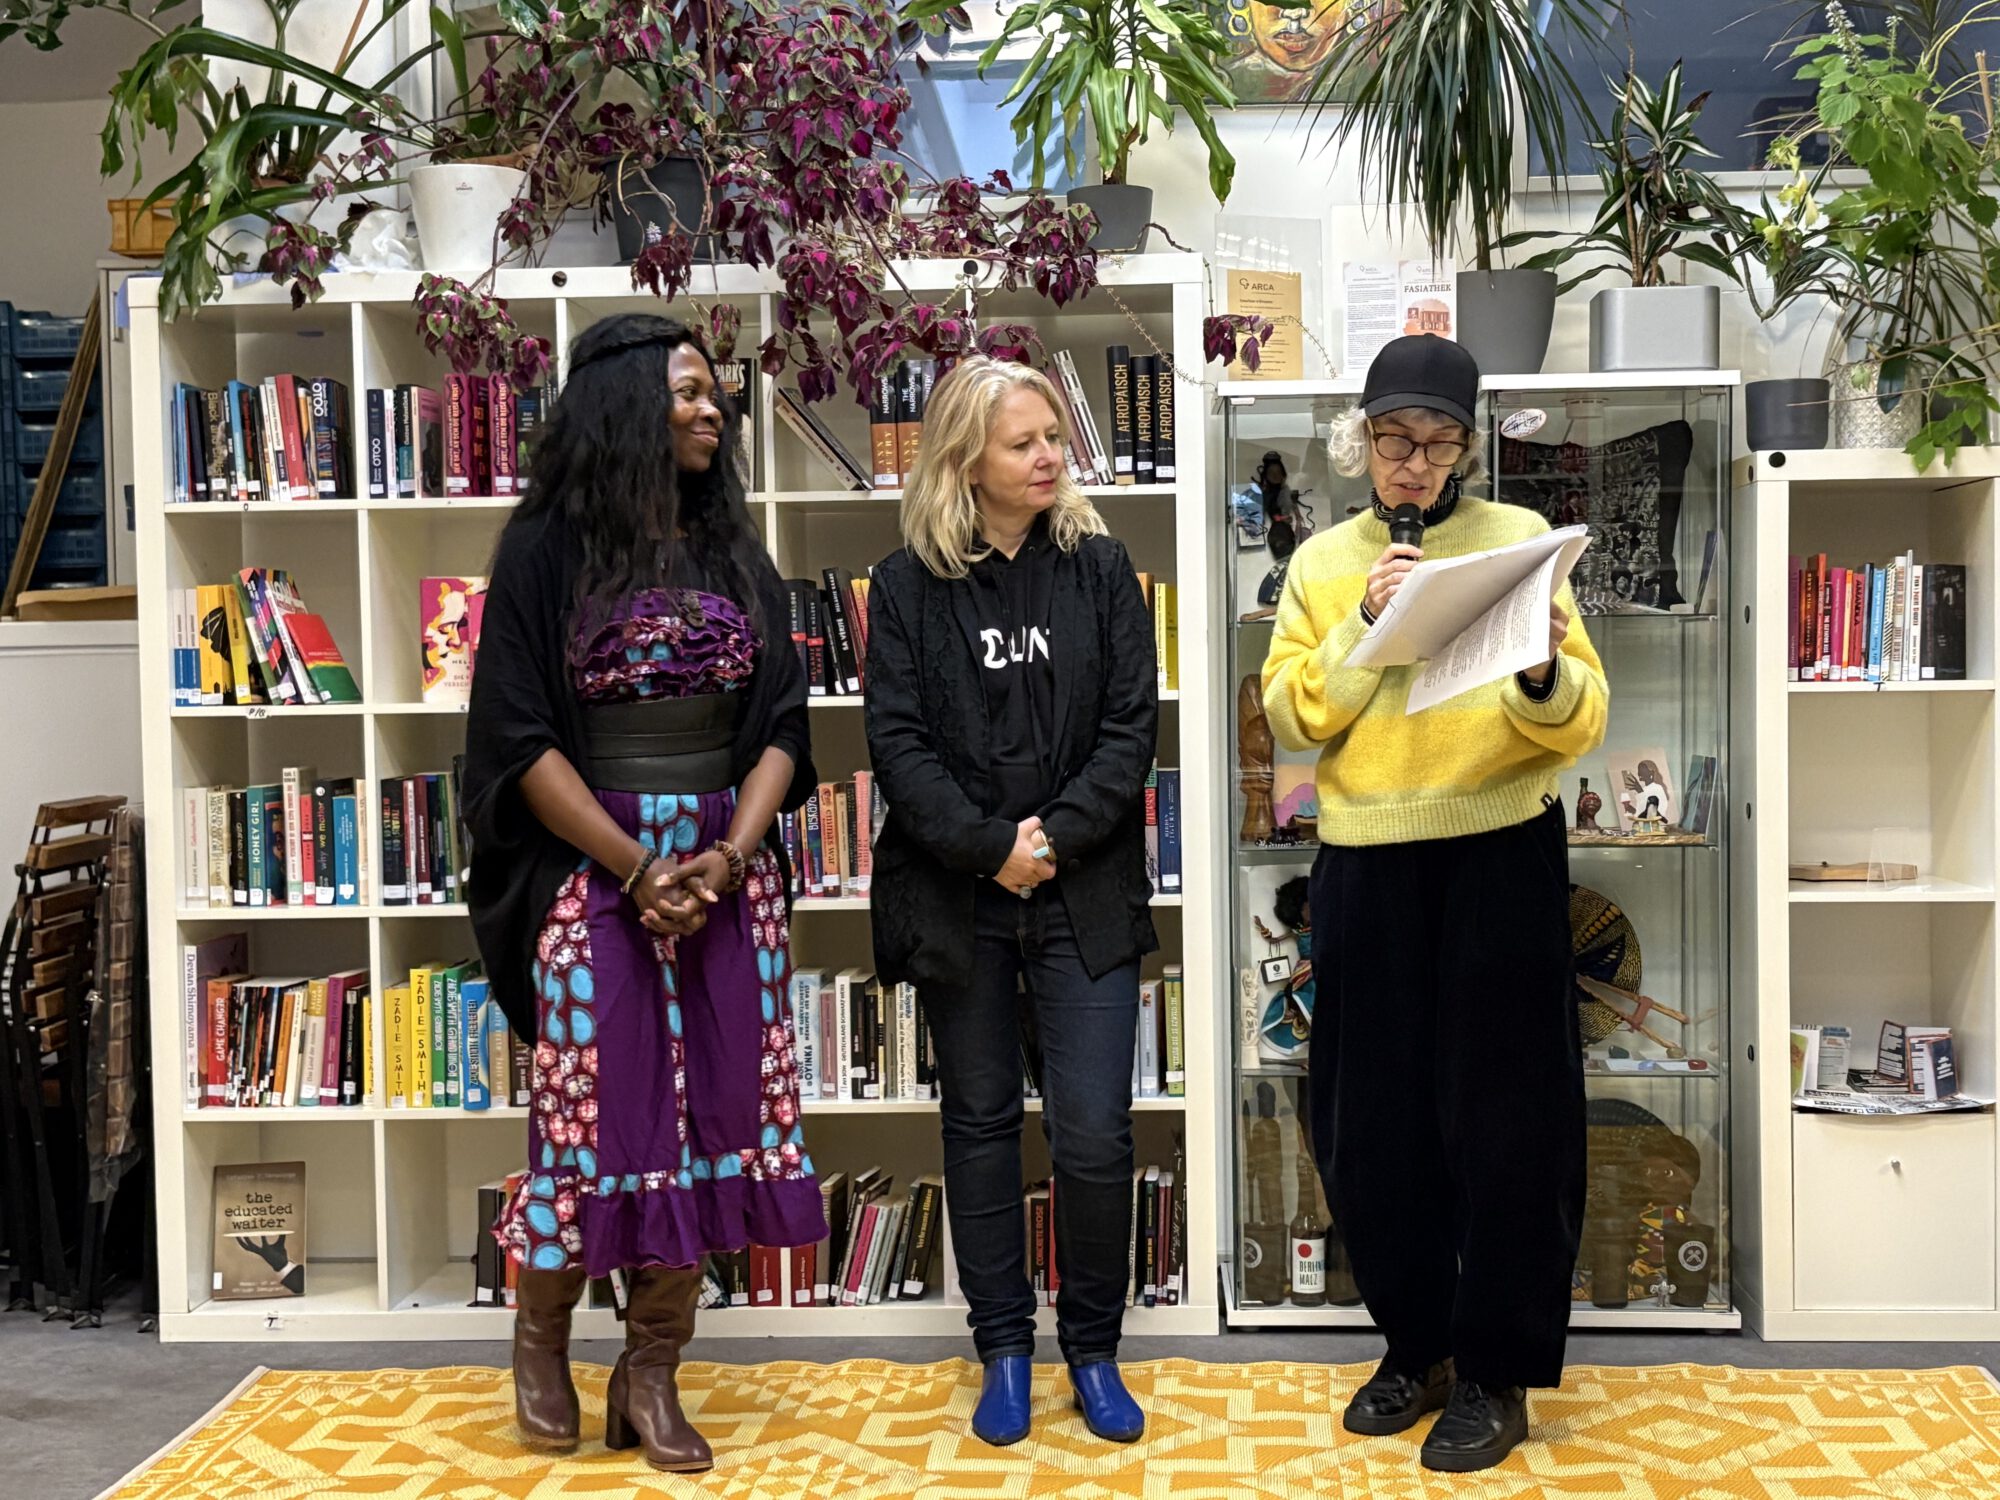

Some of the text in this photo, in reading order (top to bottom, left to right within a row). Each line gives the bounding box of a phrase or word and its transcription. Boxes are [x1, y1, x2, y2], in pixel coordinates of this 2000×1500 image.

[1404, 284, 1452, 293] FASIATHEK
[312, 382, 324, 416] OTOO
[1114, 364, 1130, 432] AFROPÄISCH
[1136, 374, 1151, 442] AFROPÄISCH
[1157, 372, 1172, 440] AFROPÄISCH
[208, 392, 224, 478] Black and British
[372, 438, 381, 466] OTOO
[1854, 580, 1862, 626] AMANDLA
[315, 802, 328, 870] why we matter
[434, 981, 442, 996] ZADIE
[447, 978, 457, 1001] ZADIE
[186, 954, 196, 1048] Devan Shimoyama
[417, 975, 426, 1090] ZADIE SMITH
[447, 1027, 457, 1052] GRAND
[216, 1038, 225, 1061] GAME
[447, 1053, 457, 1076] UNION
[224, 1203, 293, 1217] educated
[246, 1192, 272, 1204] the
[232, 1217, 286, 1230] waiter
[1300, 1261, 1324, 1272] BERLIN
[1300, 1274, 1318, 1285] MALZ
[267, 1317, 278, 1327] T
